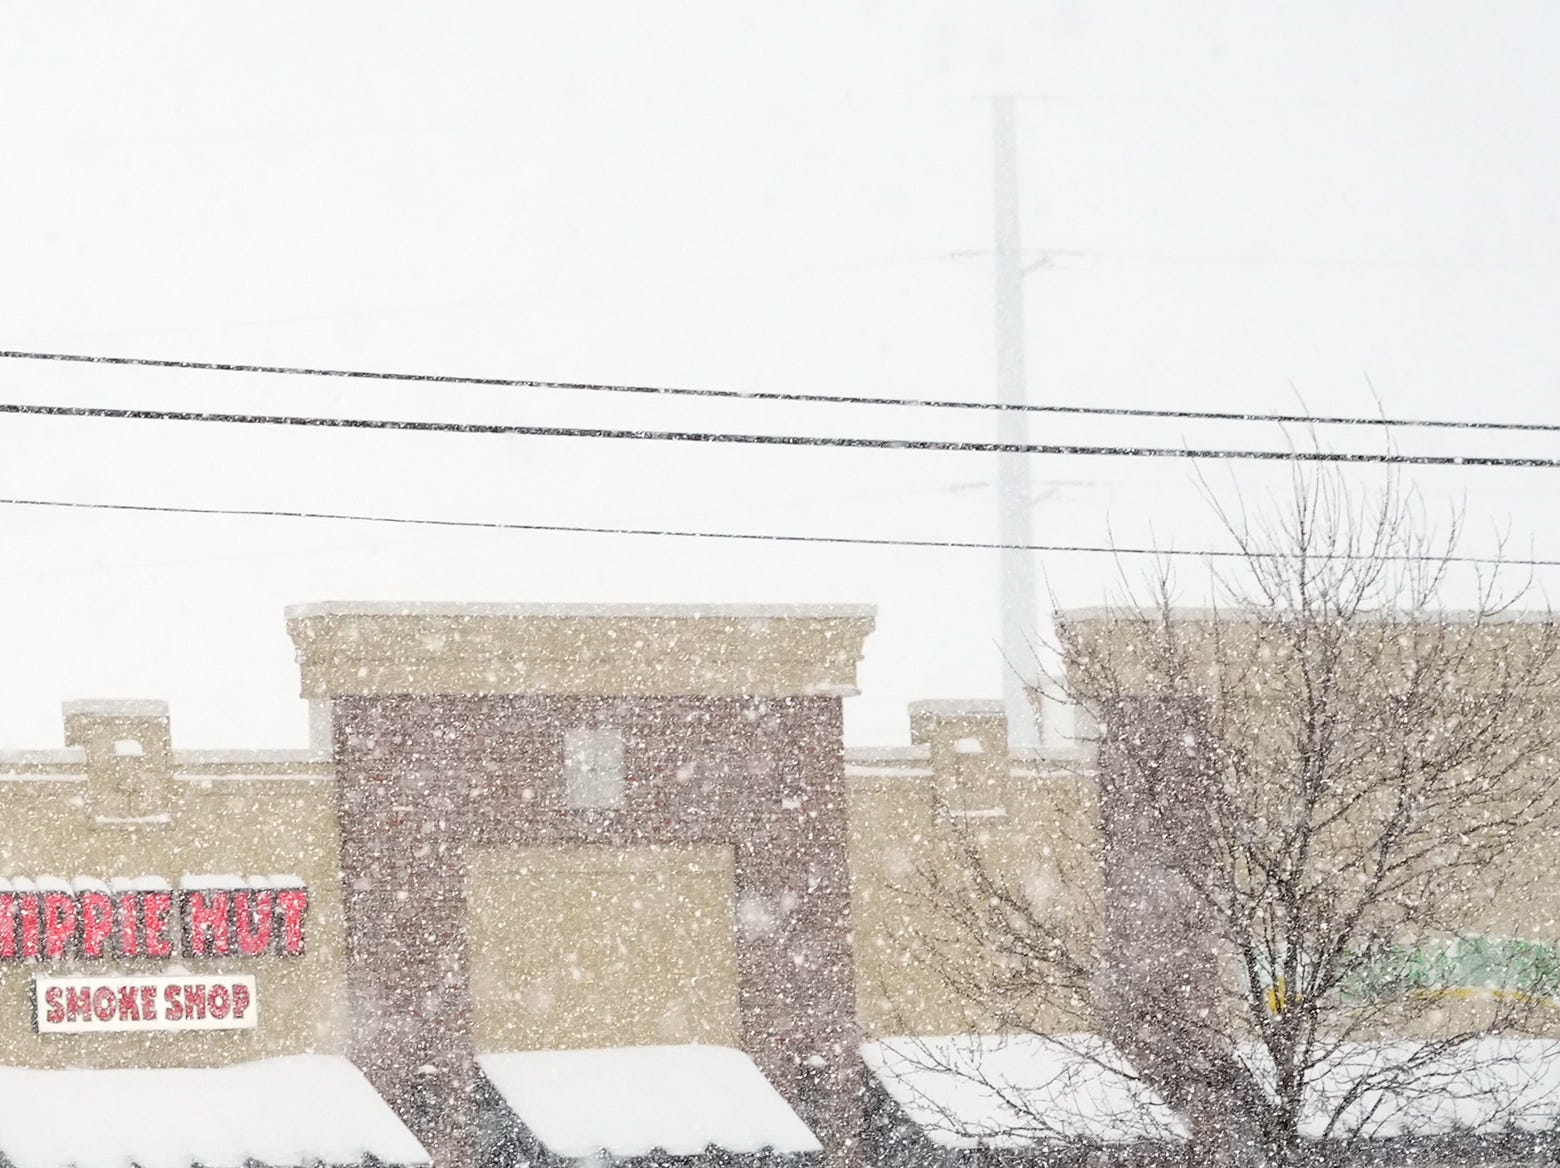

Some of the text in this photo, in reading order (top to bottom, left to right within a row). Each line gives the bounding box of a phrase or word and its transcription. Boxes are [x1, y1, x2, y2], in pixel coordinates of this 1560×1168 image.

[182, 889, 309, 958] HUT
[45, 983, 250, 1023] SMOKE SHOP
